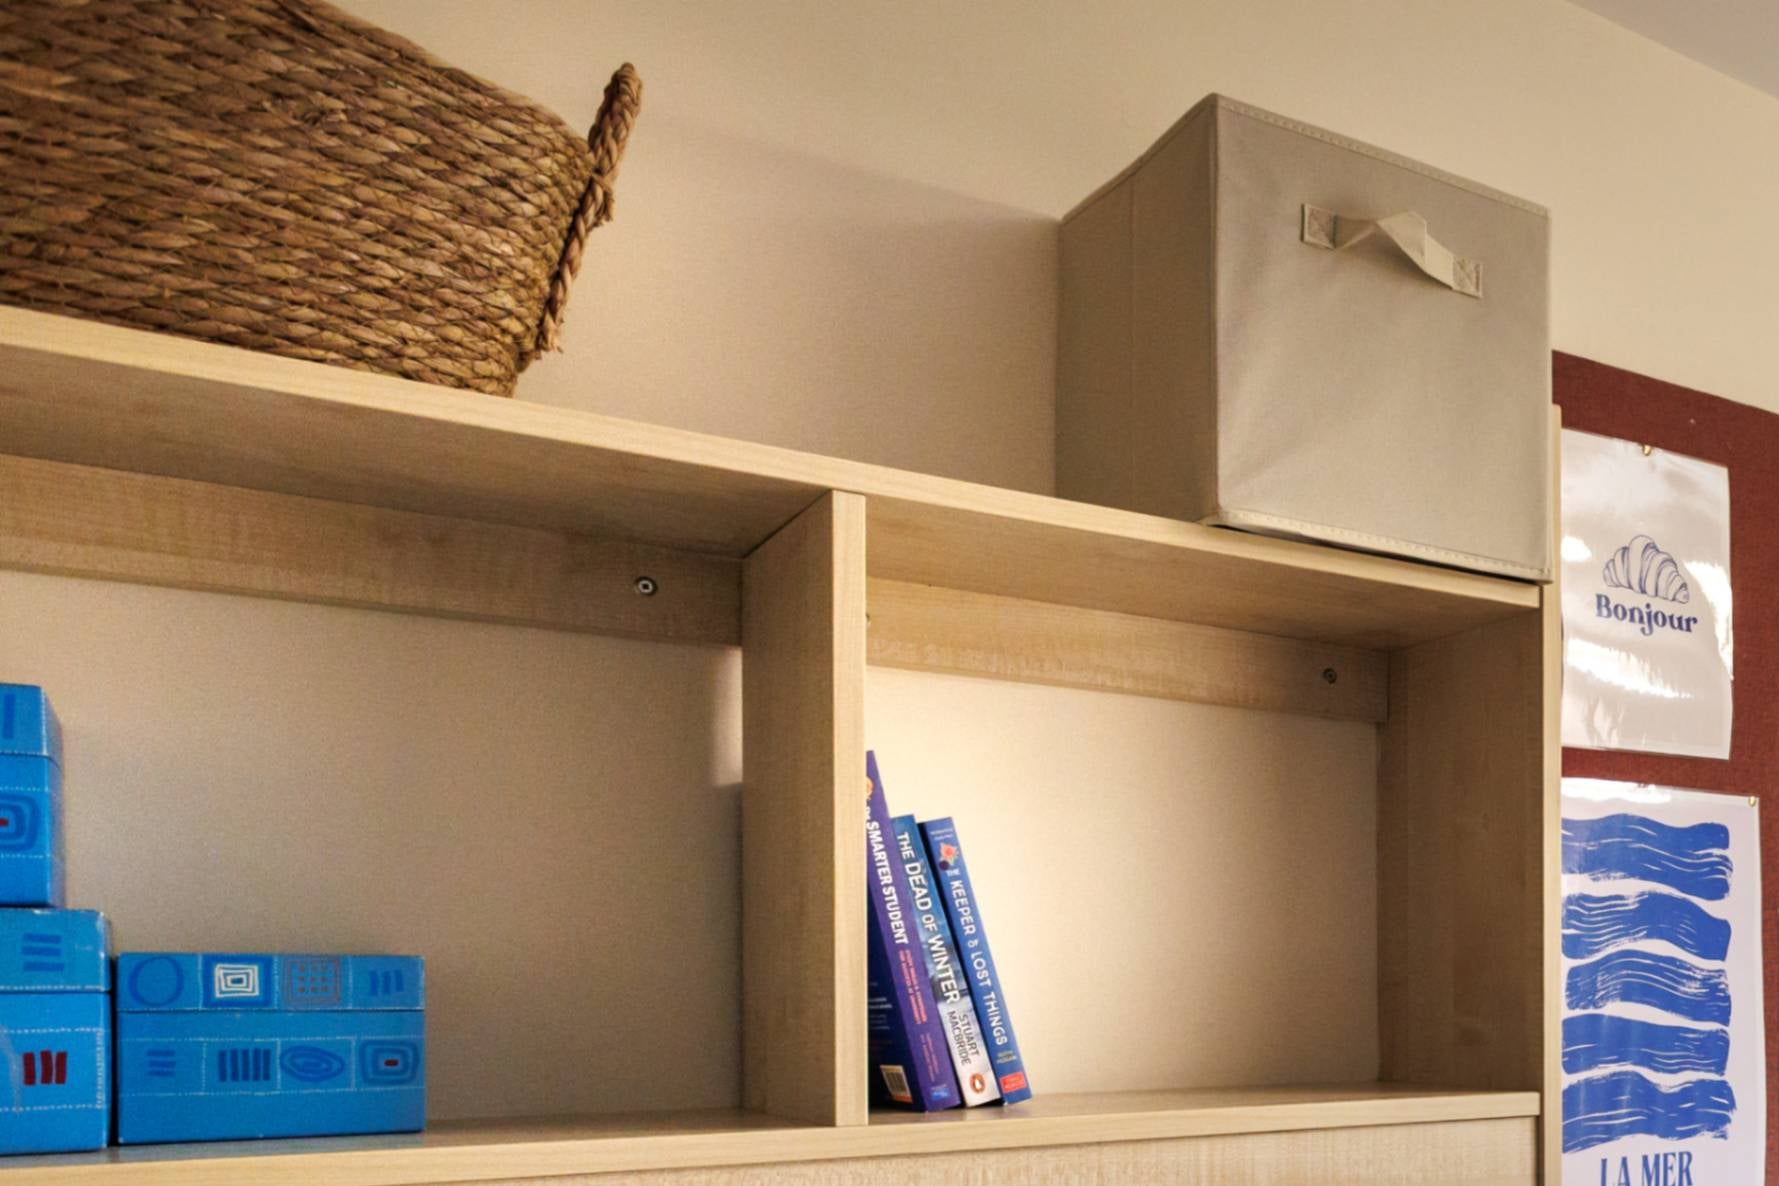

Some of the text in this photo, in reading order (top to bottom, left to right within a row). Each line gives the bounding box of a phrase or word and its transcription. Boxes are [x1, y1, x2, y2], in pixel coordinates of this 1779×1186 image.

[1595, 593, 1698, 636] Bonjour
[897, 832, 915, 859] THE
[866, 821, 909, 944] SMARTER STUDENT
[904, 862, 932, 911] DEAD
[922, 914, 938, 932] OF
[927, 934, 962, 1005] WINTER
[950, 879, 977, 936] KEEPER
[970, 951, 992, 988] LOST
[983, 991, 1008, 1046] THINGS
[948, 1010, 972, 1067] MACBRIDE
[958, 1013, 980, 1056] STUART
